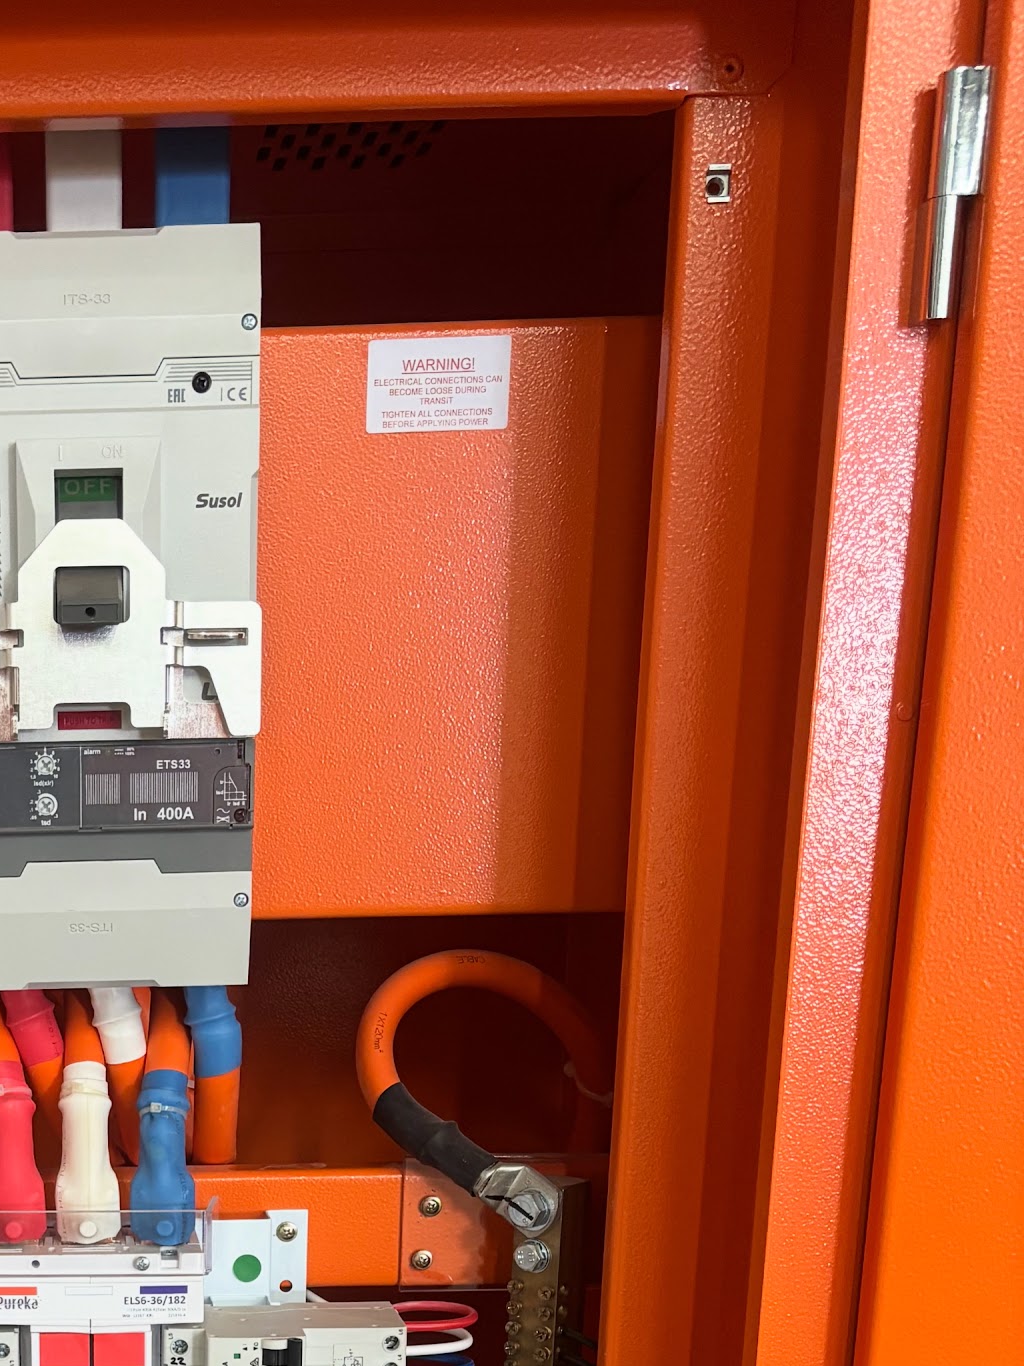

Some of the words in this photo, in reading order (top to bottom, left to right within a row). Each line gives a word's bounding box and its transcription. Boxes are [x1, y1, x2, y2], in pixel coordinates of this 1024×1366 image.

[62, 293, 112, 305] ITS-33
[402, 357, 475, 372] WARNING!
[374, 378, 423, 387] ELECTRICAL
[424, 376, 484, 385] CONNECTIONS
[485, 375, 503, 383] CAN
[389, 388, 423, 396] BECOME
[425, 387, 453, 395] LOOSE
[455, 386, 487, 394] DURING
[419, 397, 454, 405] TRANSIT
[381, 411, 416, 419] TIGHTEN
[434, 408, 493, 417] CONNECTIONS
[382, 421, 415, 429] BEFORE
[416, 419, 457, 427] APPLYING
[458, 418, 489, 426] POWER
[64, 479, 113, 496] OFF
[195, 492, 243, 508] Susol
[156, 759, 191, 769] ETS33
[133, 808, 147, 821] In
[157, 806, 194, 821] 400A
[123, 1295, 186, 1305] ELS6-36/182
[170, 1357, 187, 1366] 22
